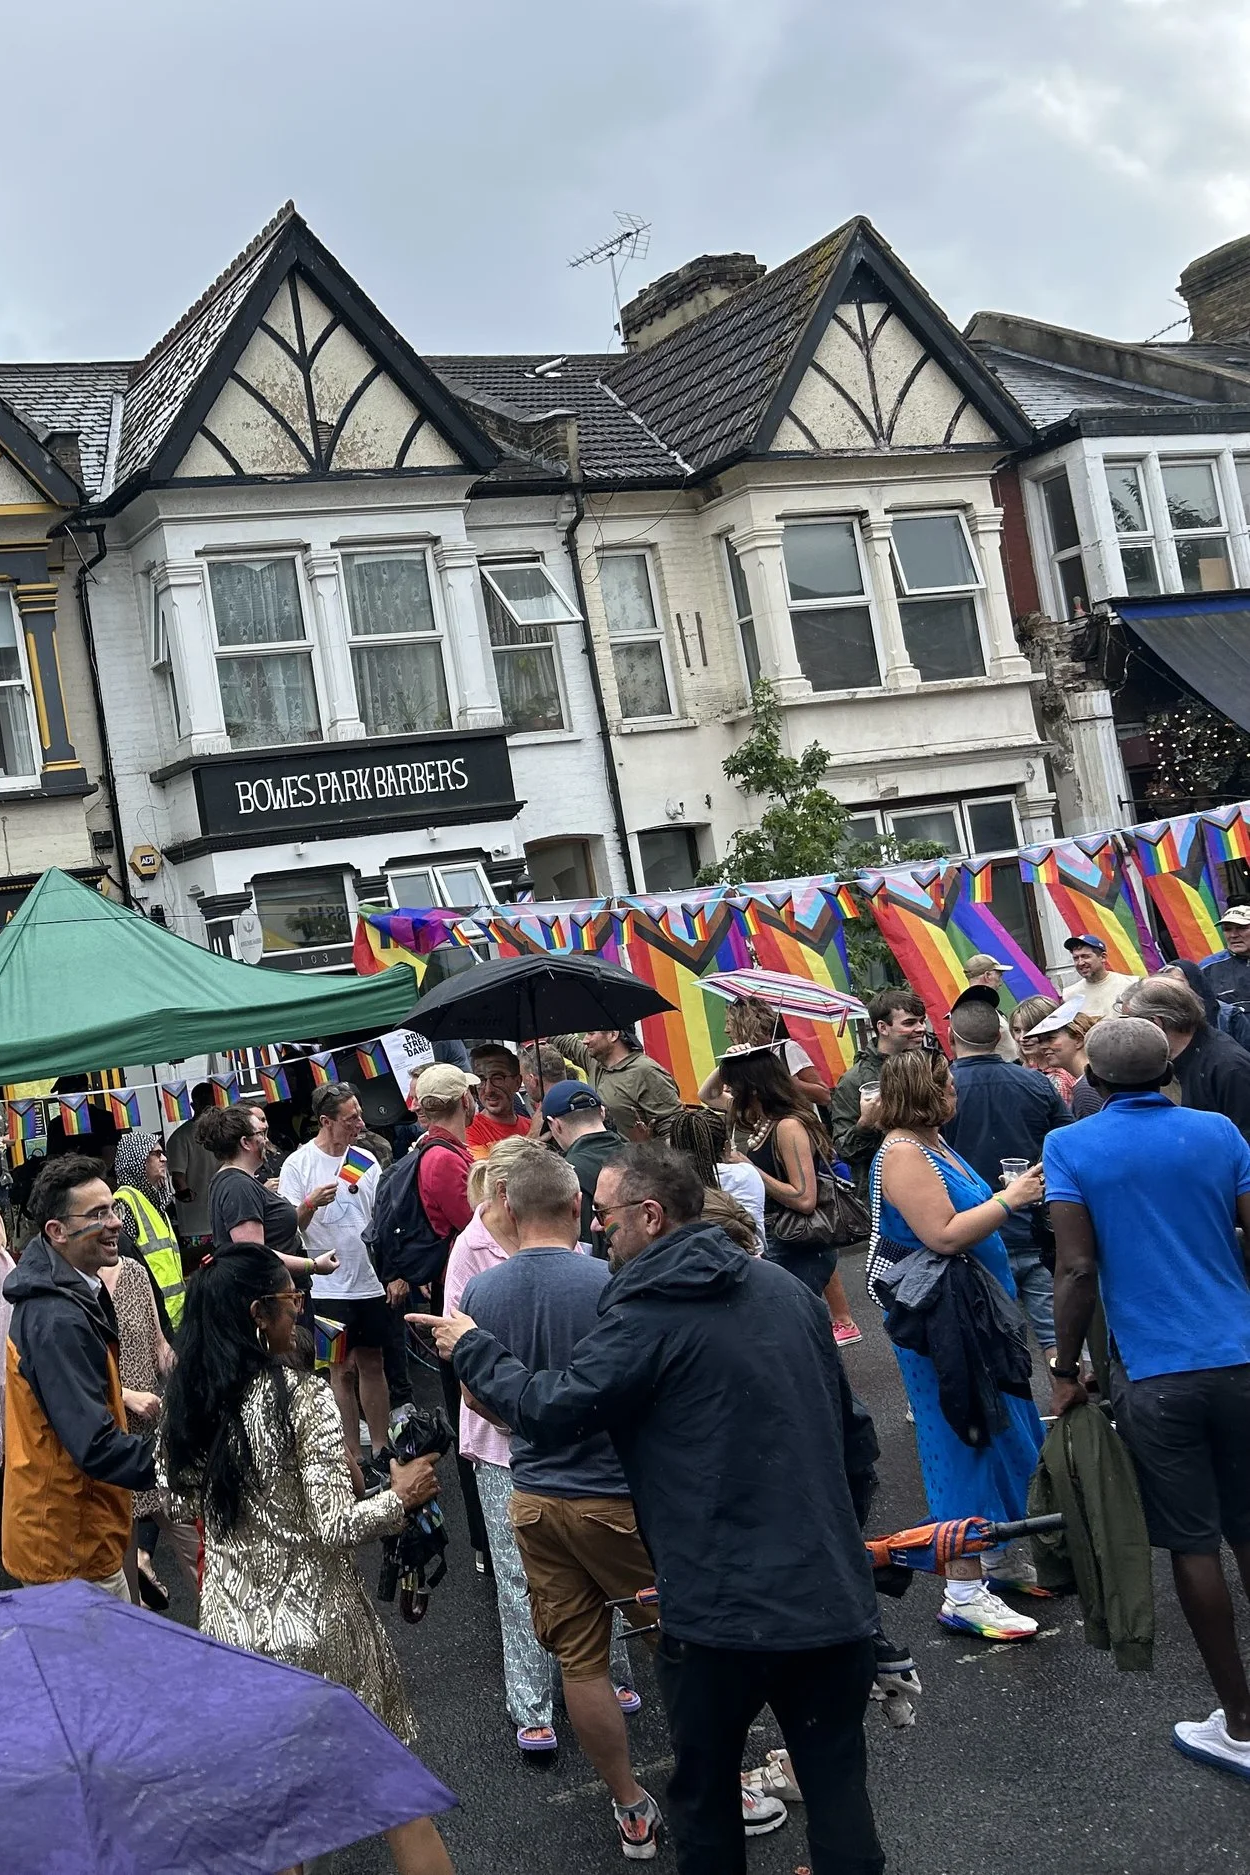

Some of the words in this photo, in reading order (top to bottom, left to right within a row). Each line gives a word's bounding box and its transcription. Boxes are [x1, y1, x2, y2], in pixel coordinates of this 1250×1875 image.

[235, 774, 316, 814] BOWES
[315, 767, 373, 805] PARK
[373, 758, 469, 798] BARBERS
[141, 856, 154, 865] ADT
